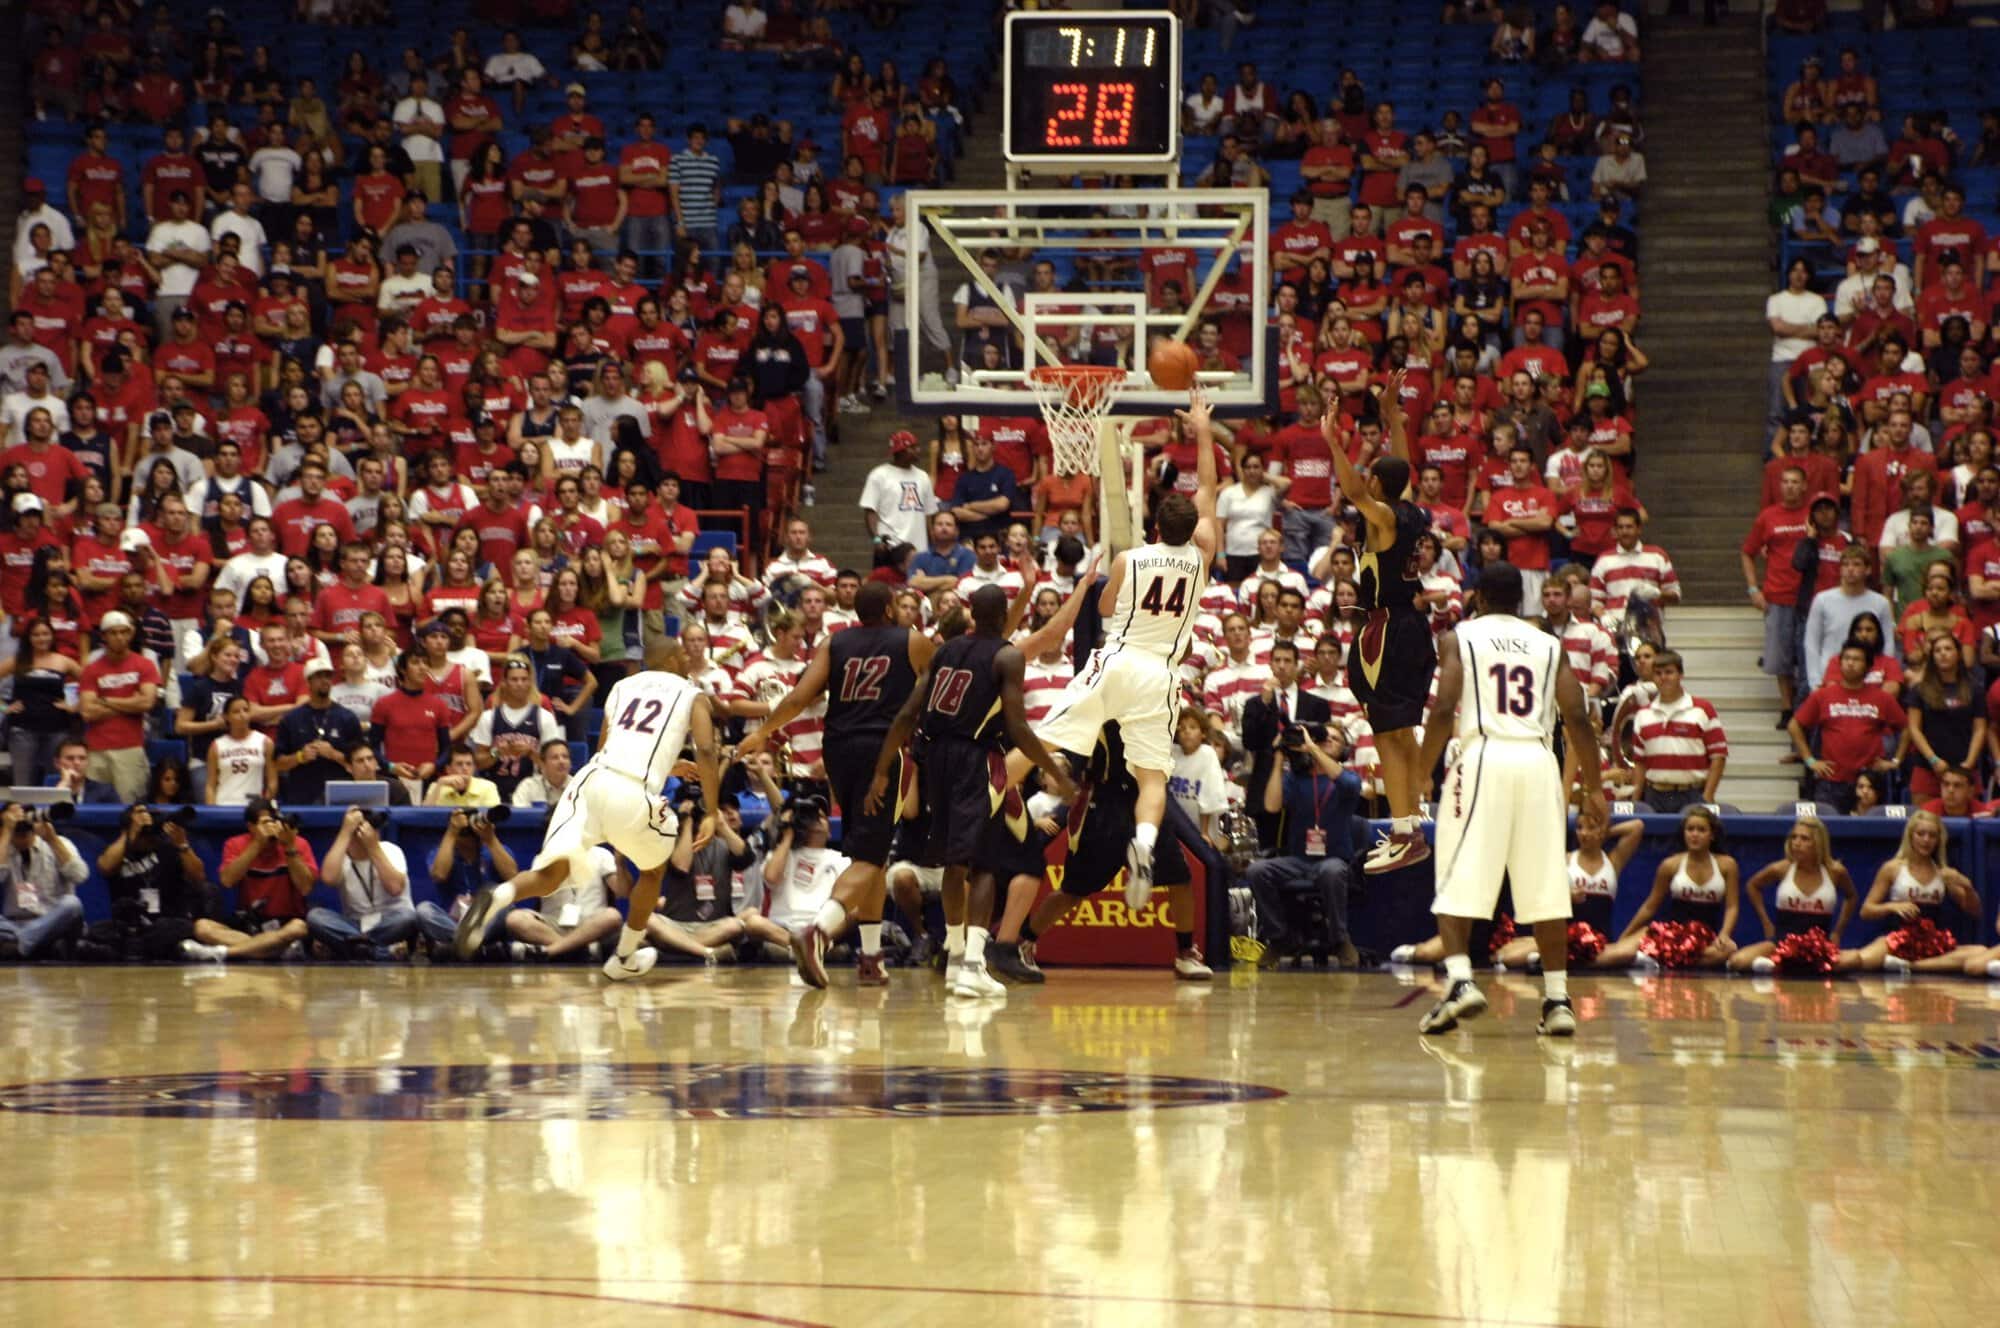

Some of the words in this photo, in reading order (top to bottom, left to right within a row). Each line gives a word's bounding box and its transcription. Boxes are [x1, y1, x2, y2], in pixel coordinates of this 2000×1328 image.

[1058, 27, 1156, 68] 7:11
[1046, 83, 1135, 146] 28
[1141, 575, 1187, 617] 44
[1490, 637, 1531, 655] WISE
[840, 656, 891, 702] 12
[1489, 663, 1534, 718] 13
[617, 697, 663, 735] 42
